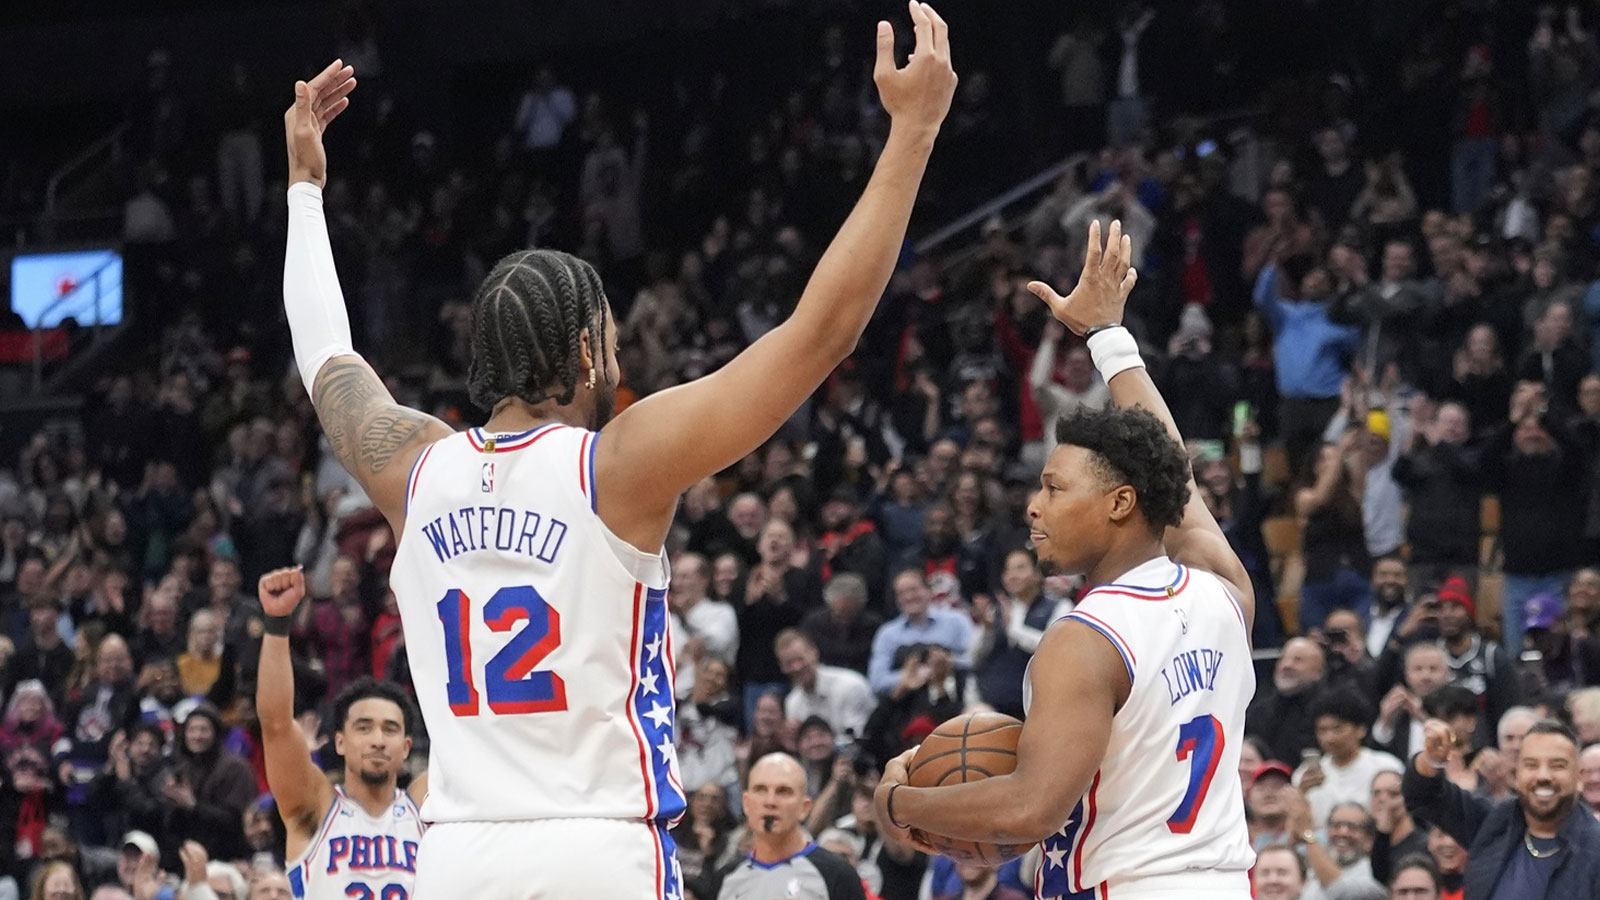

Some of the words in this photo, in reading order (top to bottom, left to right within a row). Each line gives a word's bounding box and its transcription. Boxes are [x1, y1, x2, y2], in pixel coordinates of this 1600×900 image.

[422, 506, 568, 564] WATFORD
[437, 585, 568, 717] 12
[1161, 648, 1223, 706] LOWRY
[1166, 713, 1225, 834] 7
